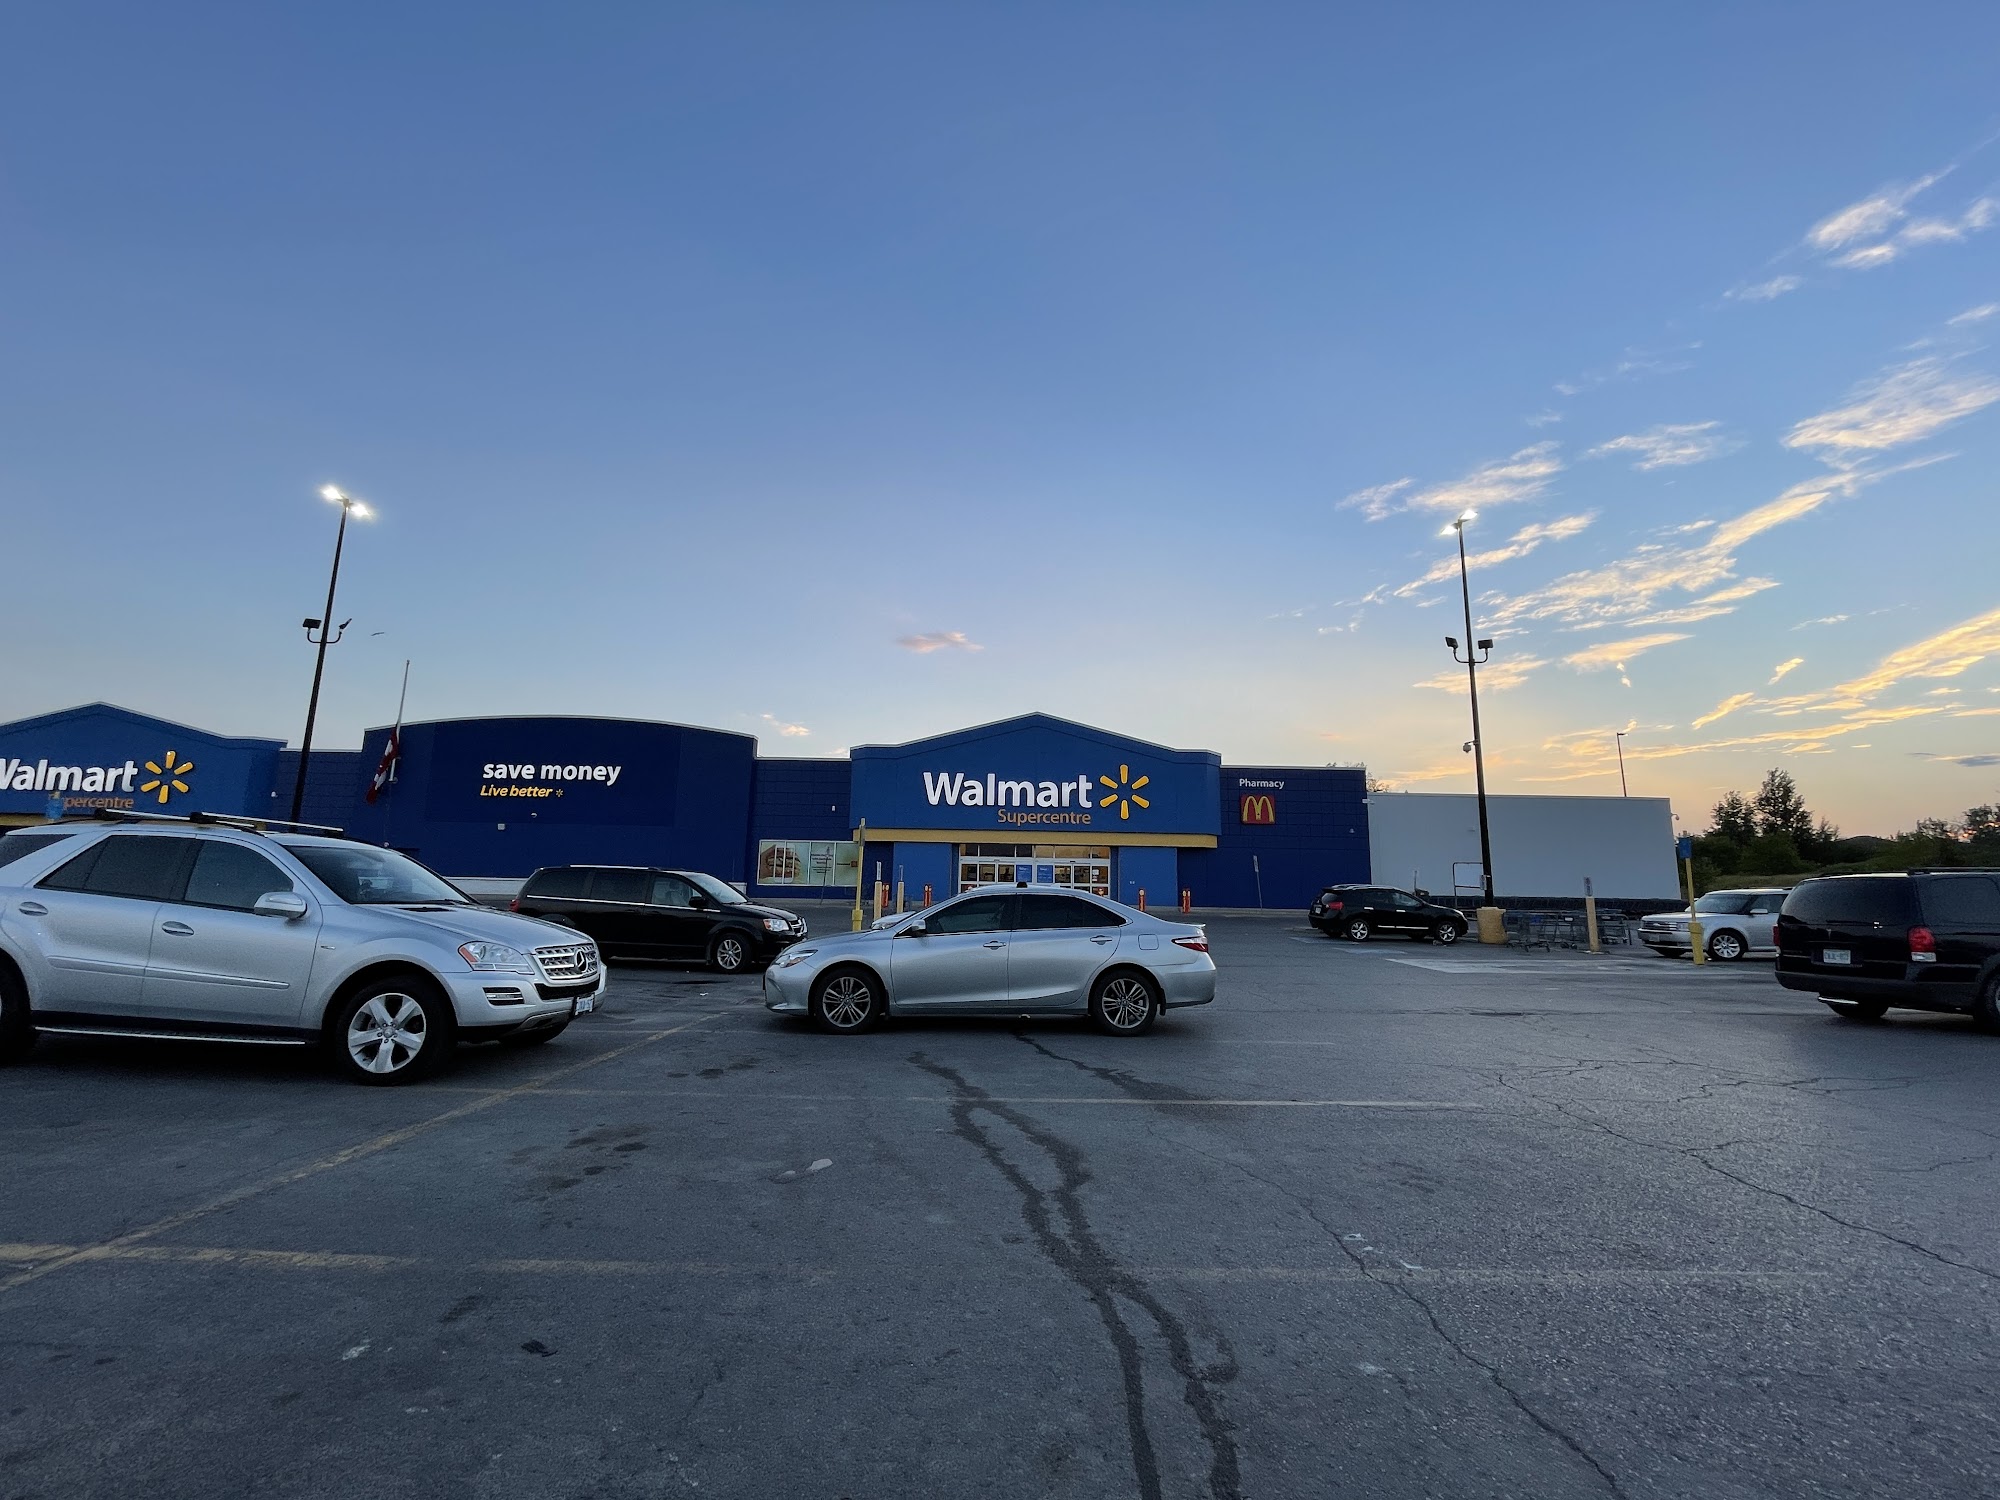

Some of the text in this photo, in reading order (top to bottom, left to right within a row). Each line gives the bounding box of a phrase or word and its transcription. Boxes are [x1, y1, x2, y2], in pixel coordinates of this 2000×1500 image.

[482, 763, 622, 786] save money
[480, 784, 553, 798] Live better
[923, 771, 1093, 808] Walmart
[1239, 778, 1285, 790] Pharmacy
[49, 795, 135, 810] percentre
[997, 808, 1092, 827] Supercentre
